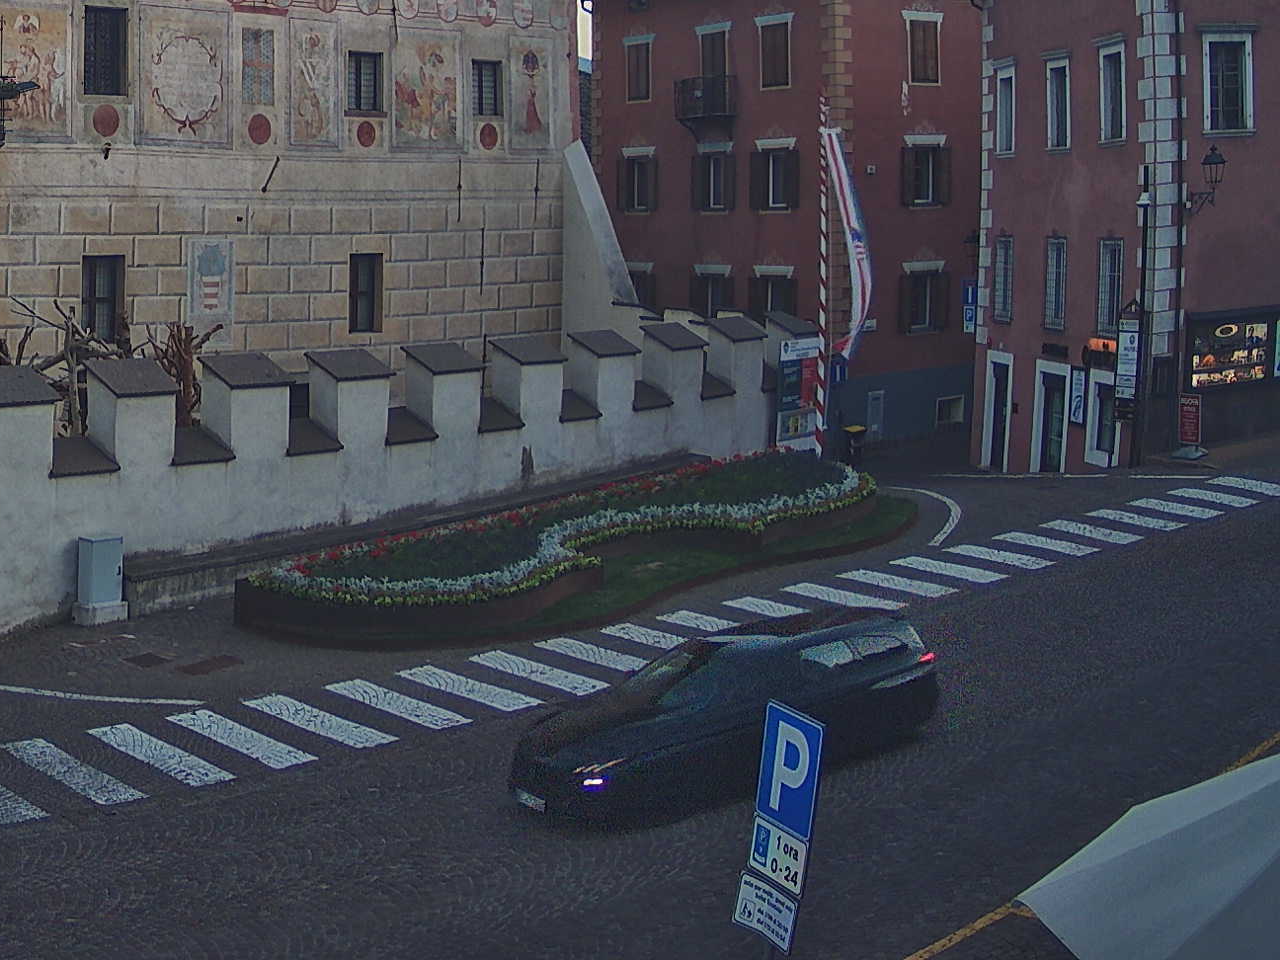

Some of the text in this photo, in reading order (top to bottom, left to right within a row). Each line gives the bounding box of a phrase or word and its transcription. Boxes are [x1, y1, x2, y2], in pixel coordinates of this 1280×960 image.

[769, 720, 810, 812] P
[776, 834, 799, 861] 1 ora
[770, 857, 799, 888] 0-24
